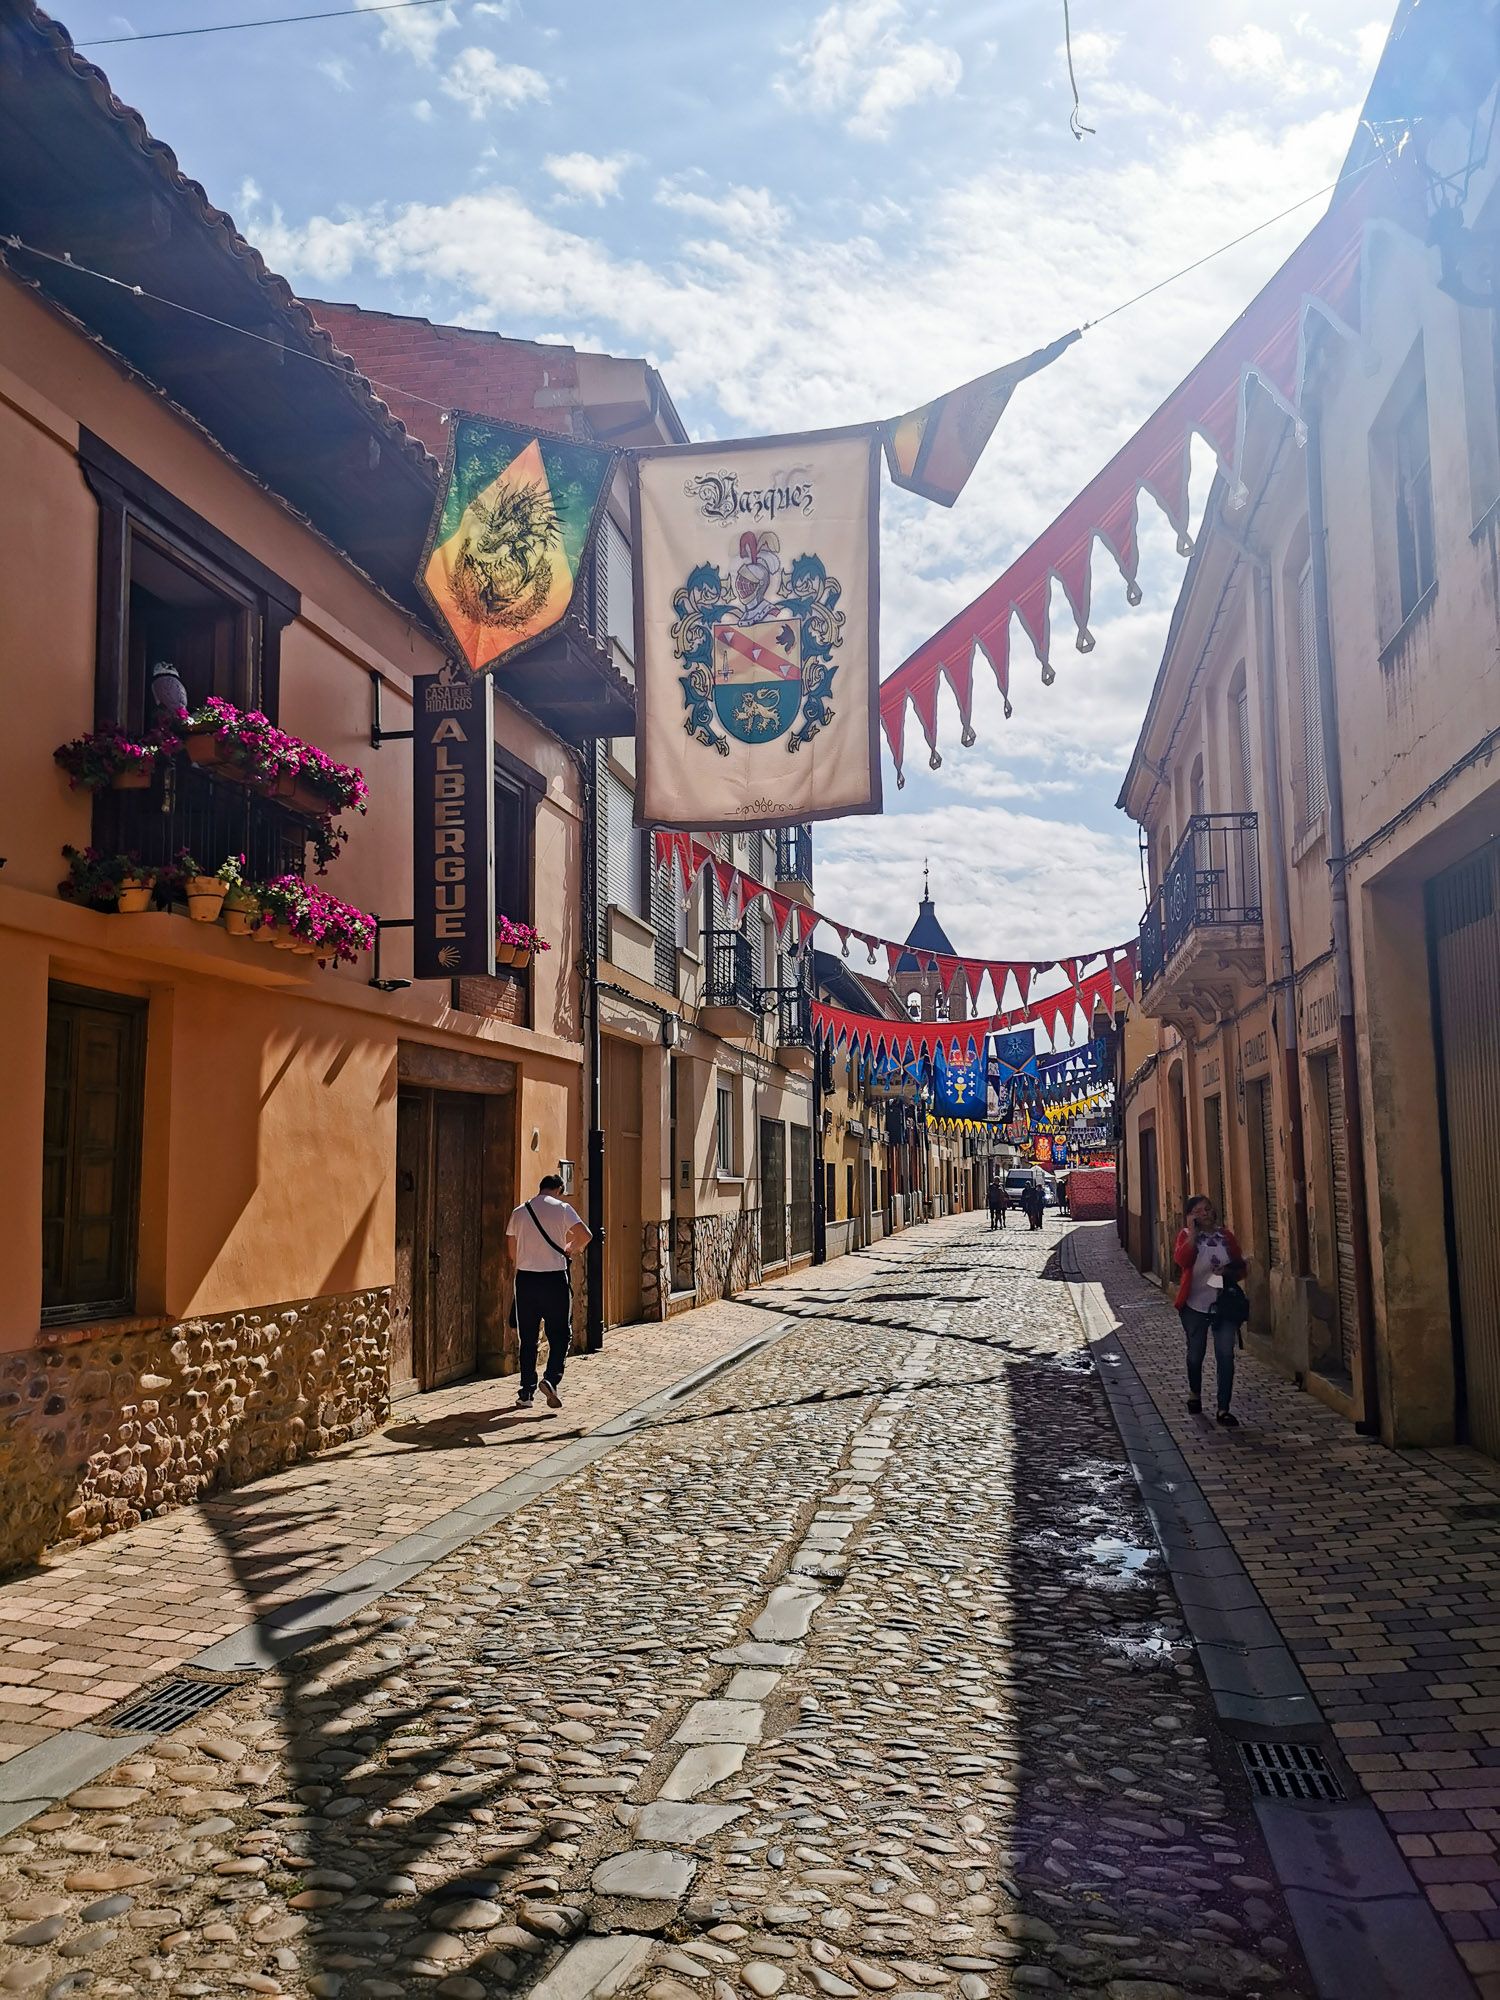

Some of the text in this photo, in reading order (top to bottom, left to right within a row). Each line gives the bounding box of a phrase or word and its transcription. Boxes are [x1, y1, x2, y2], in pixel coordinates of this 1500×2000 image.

[684, 468, 815, 527] Vazquez
[425, 687, 450, 701] CASA
[425, 697, 472, 712] HIDALGOS
[431, 717, 469, 939] ALBERGUE
